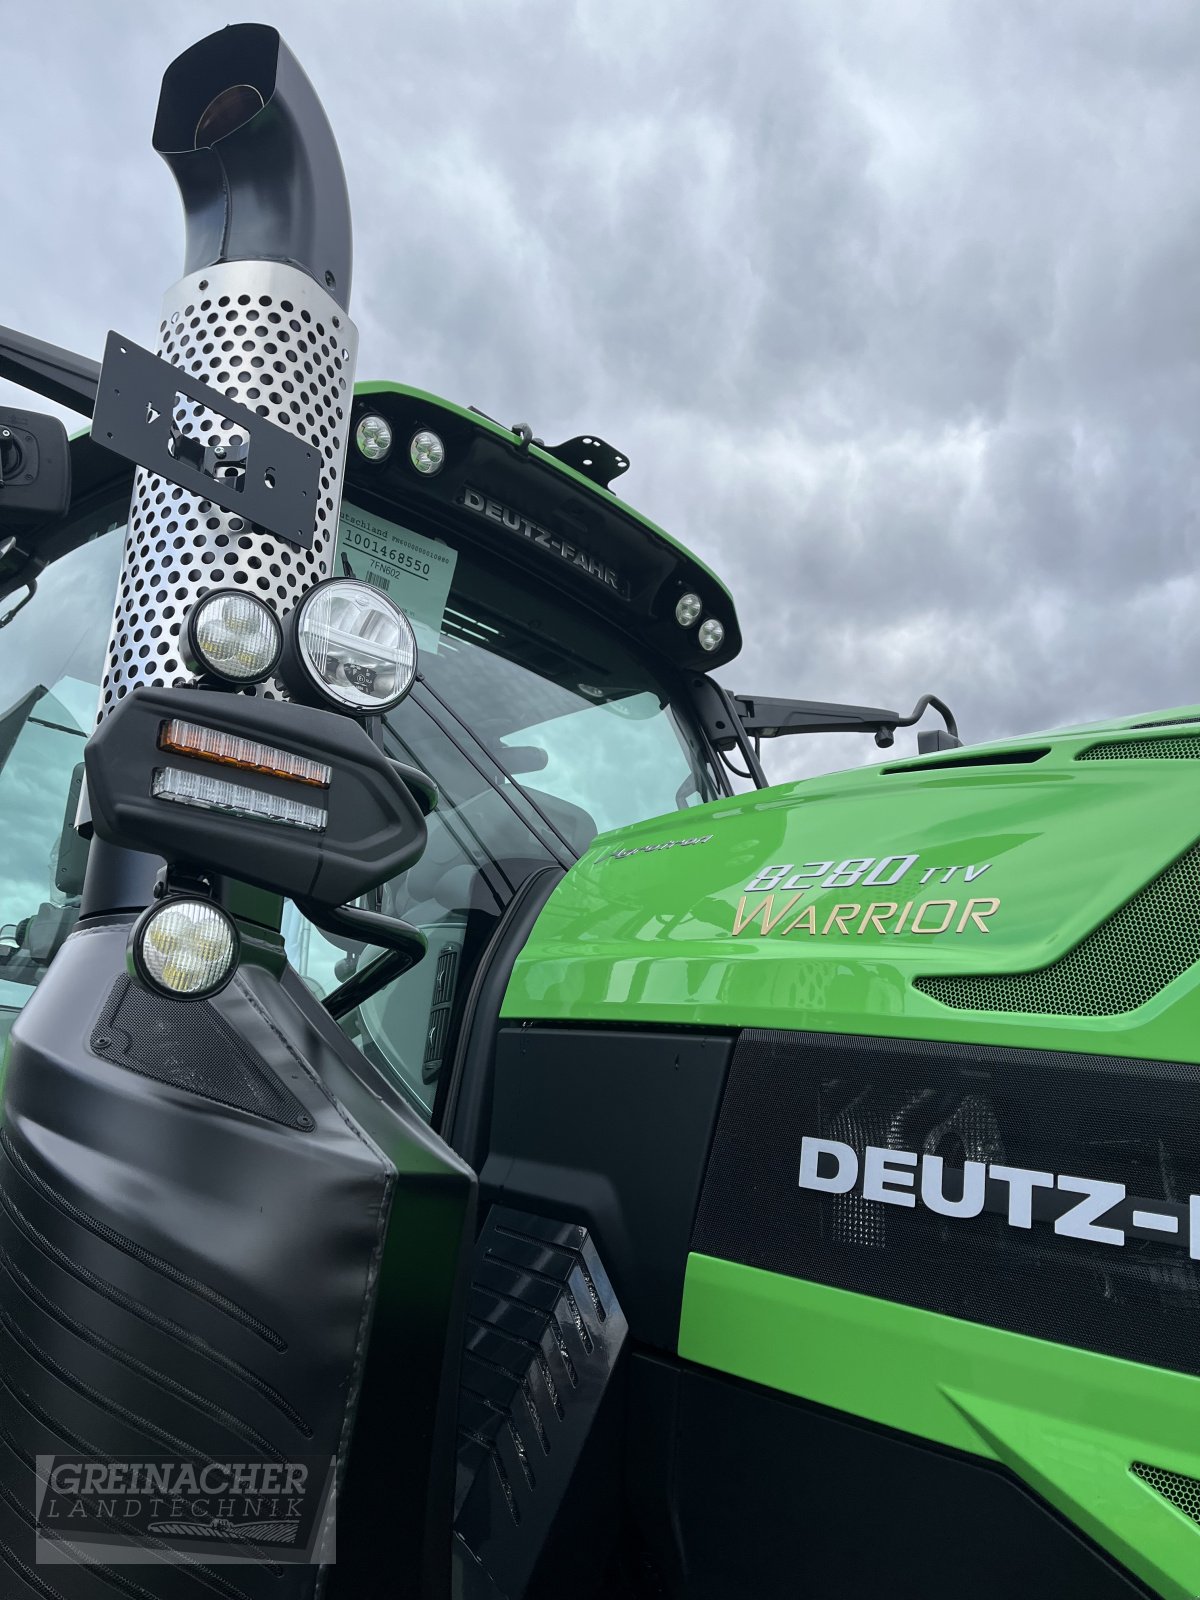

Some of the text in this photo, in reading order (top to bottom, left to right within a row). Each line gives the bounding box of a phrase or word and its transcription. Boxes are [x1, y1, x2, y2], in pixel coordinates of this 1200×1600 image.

[345, 529, 430, 574] 1001468550
[463, 487, 619, 590] DEUTZ-FAHR
[370, 558, 401, 580] 7FN602
[744, 854, 993, 892] 8280 TTV
